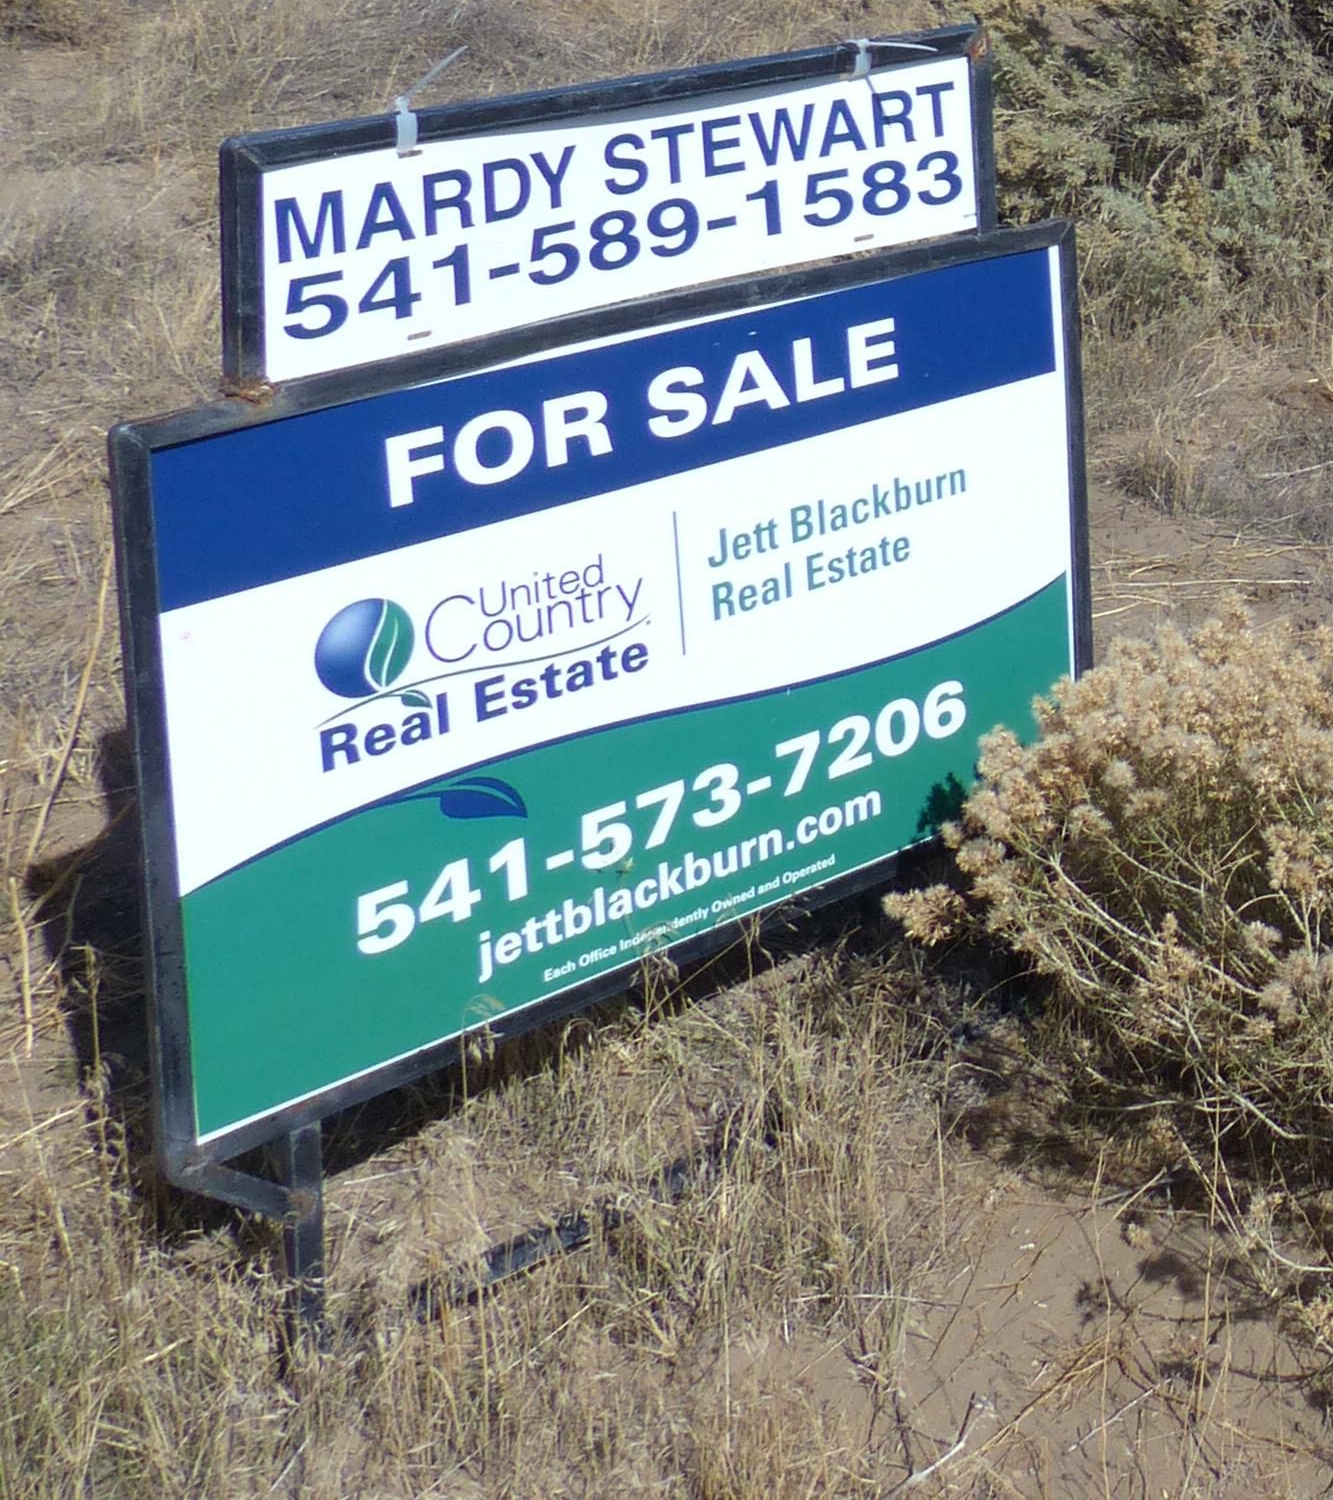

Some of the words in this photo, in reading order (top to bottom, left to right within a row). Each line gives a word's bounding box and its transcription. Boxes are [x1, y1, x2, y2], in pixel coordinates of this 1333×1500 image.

[274, 146, 574, 264] MARDY
[604, 82, 955, 195] STEWART
[284, 151, 963, 339] 541-589-1583
[385, 390, 613, 508] FOR
[647, 317, 899, 438] SALE
[707, 520, 780, 567] Jett
[790, 468, 968, 541] Blackburn
[711, 574, 793, 620] Real
[804, 533, 911, 589] Estate
[424, 577, 644, 663] Country
[477, 553, 605, 617] United
[319, 695, 450, 772] Real
[475, 638, 650, 722] Estate
[355, 680, 967, 955] 541-573-7206
[478, 790, 882, 982] jettblackburn.com
[543, 962, 577, 982] Each
[579, 944, 617, 967] Office
[711, 887, 756, 913] Owned
[758, 876, 781, 894] and
[782, 854, 837, 885] Operated
